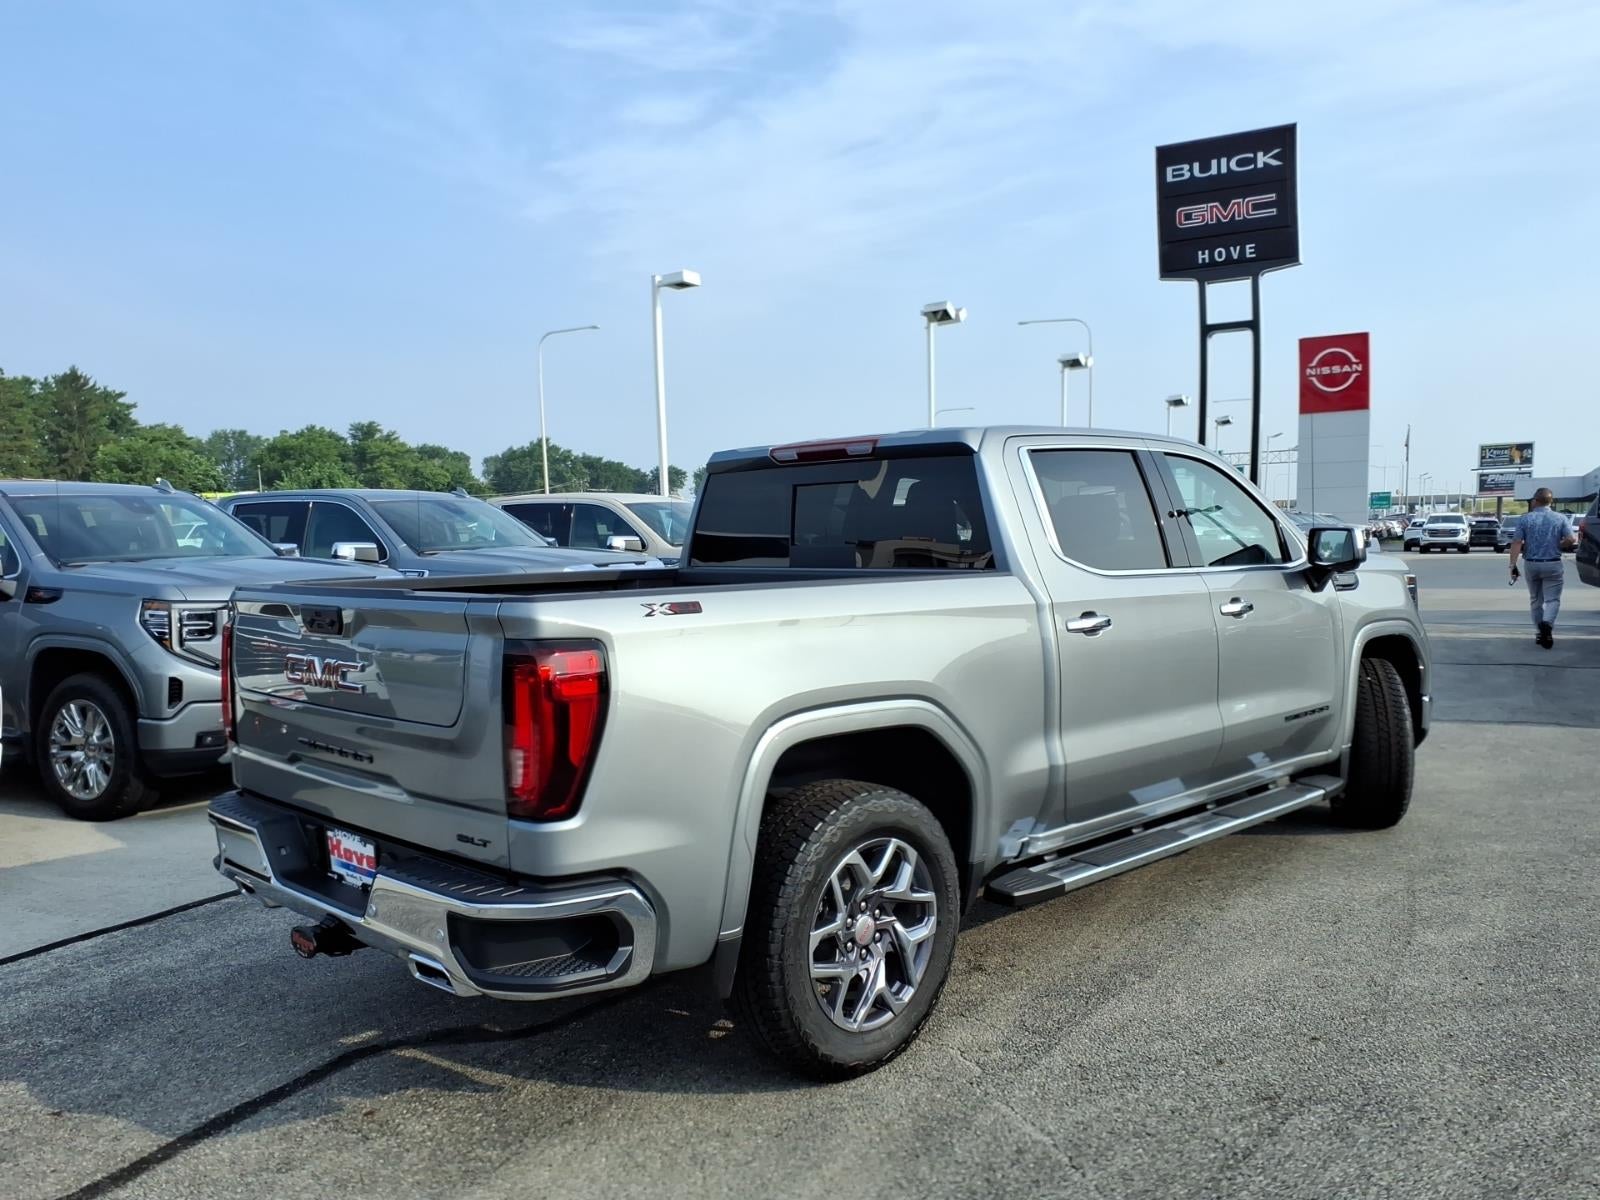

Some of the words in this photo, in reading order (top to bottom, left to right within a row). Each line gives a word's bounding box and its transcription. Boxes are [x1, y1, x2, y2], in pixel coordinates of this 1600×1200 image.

[1166, 148, 1283, 182] BUICK
[1176, 193, 1276, 228] GMC
[1197, 244, 1256, 264] HOVE
[1306, 363, 1363, 376] NISSAN
[284, 653, 367, 695] GMC
[455, 833, 492, 848] SLT
